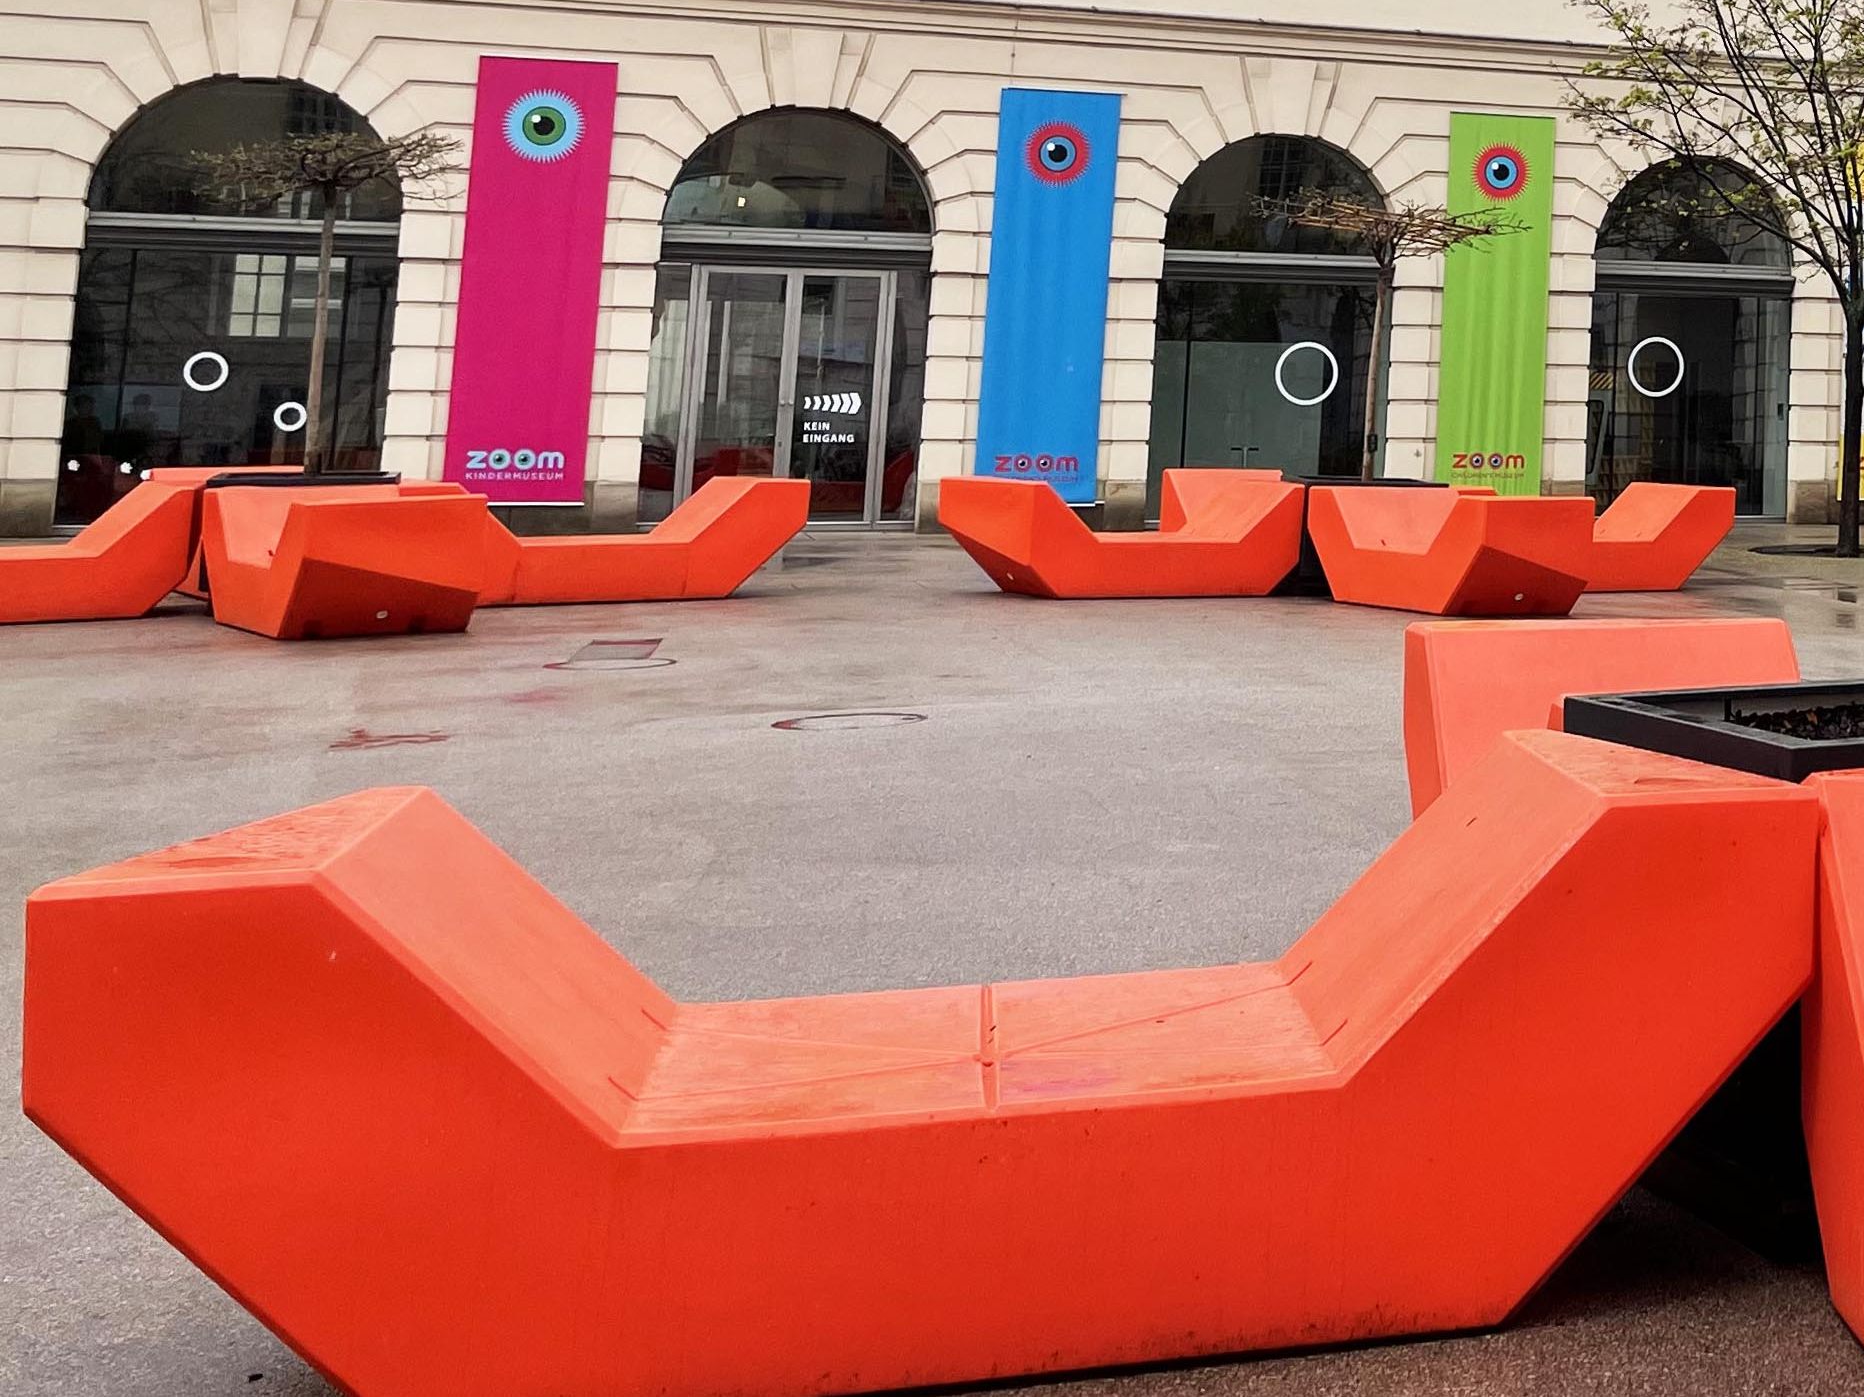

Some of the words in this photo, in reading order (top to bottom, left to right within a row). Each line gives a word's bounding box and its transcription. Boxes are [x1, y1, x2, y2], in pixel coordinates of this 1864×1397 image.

[804, 422, 830, 430] KEIN
[803, 434, 854, 443] EINGANG
[465, 472, 564, 480] KINDERMUSEUM
